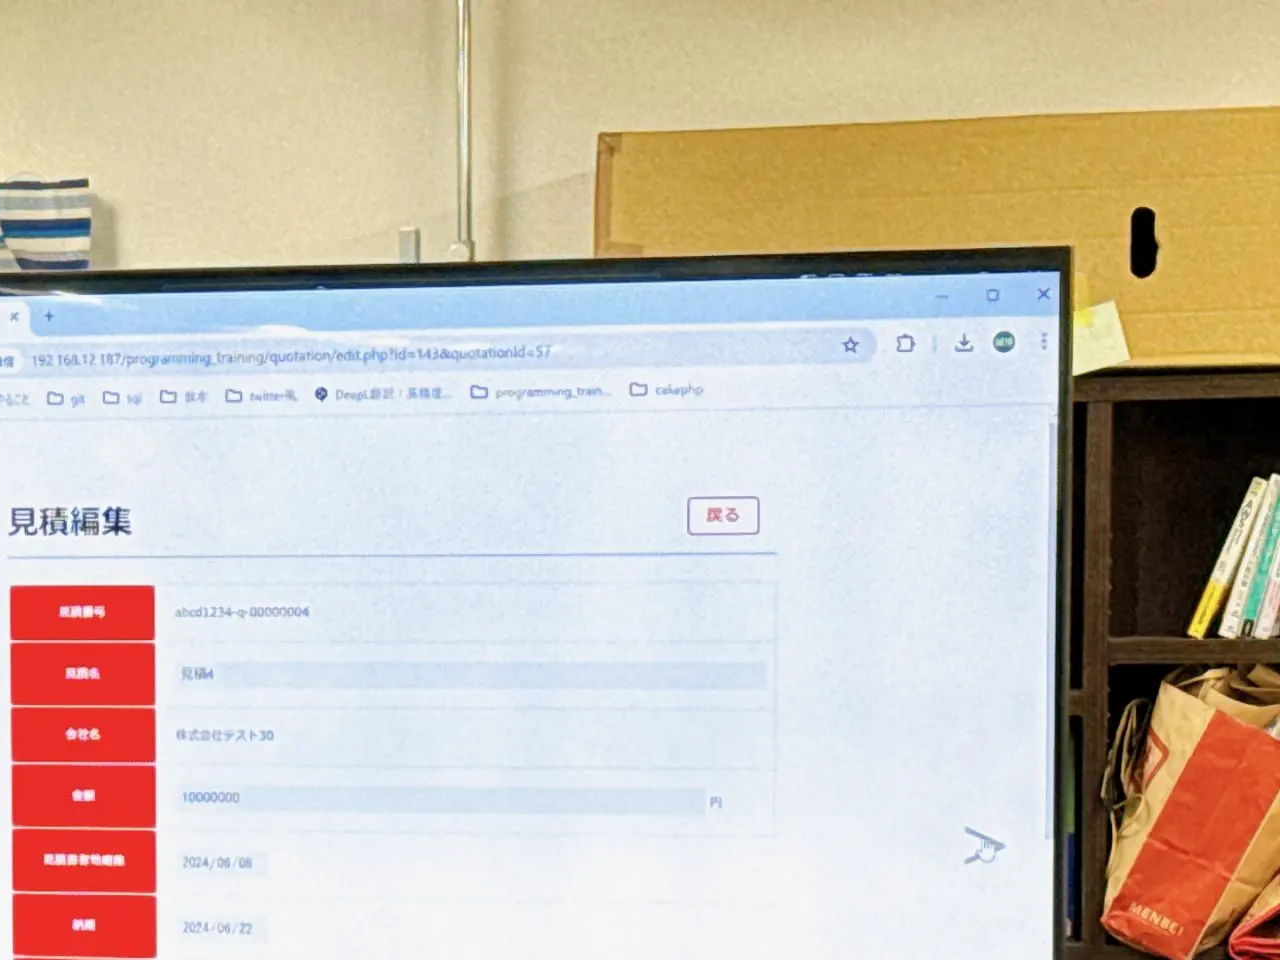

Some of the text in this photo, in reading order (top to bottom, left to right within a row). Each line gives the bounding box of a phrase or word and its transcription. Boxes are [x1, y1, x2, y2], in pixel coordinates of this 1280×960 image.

[8, 506, 133, 537] 見積編集
[706, 507, 740, 523] 戻る
